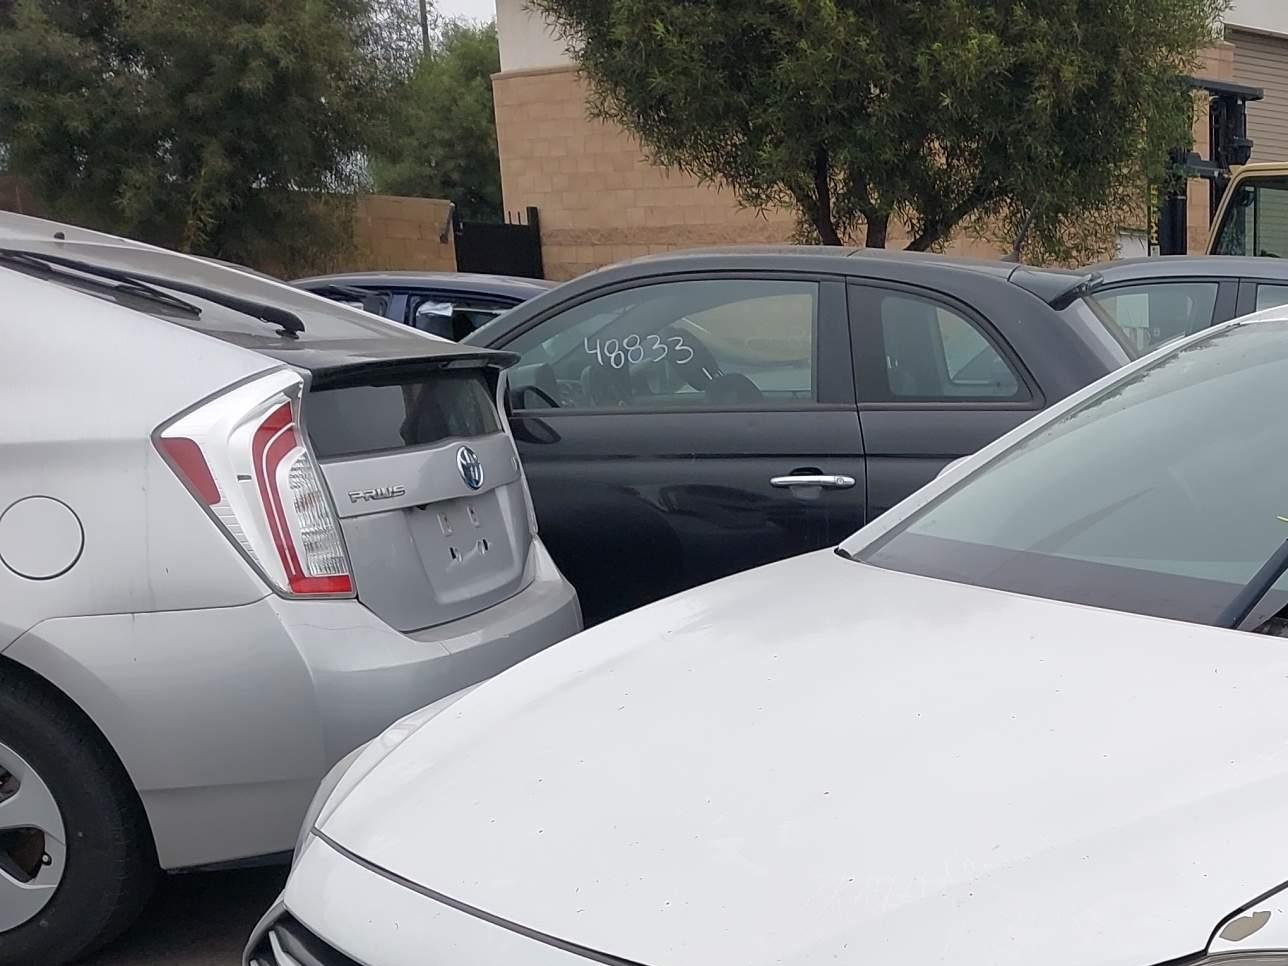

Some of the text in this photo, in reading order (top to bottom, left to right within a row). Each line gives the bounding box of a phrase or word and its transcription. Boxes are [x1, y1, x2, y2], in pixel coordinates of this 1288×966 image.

[1150, 184, 1159, 244] HYSTER
[584, 334, 695, 369] 48833
[348, 485, 408, 504] PRIUS
